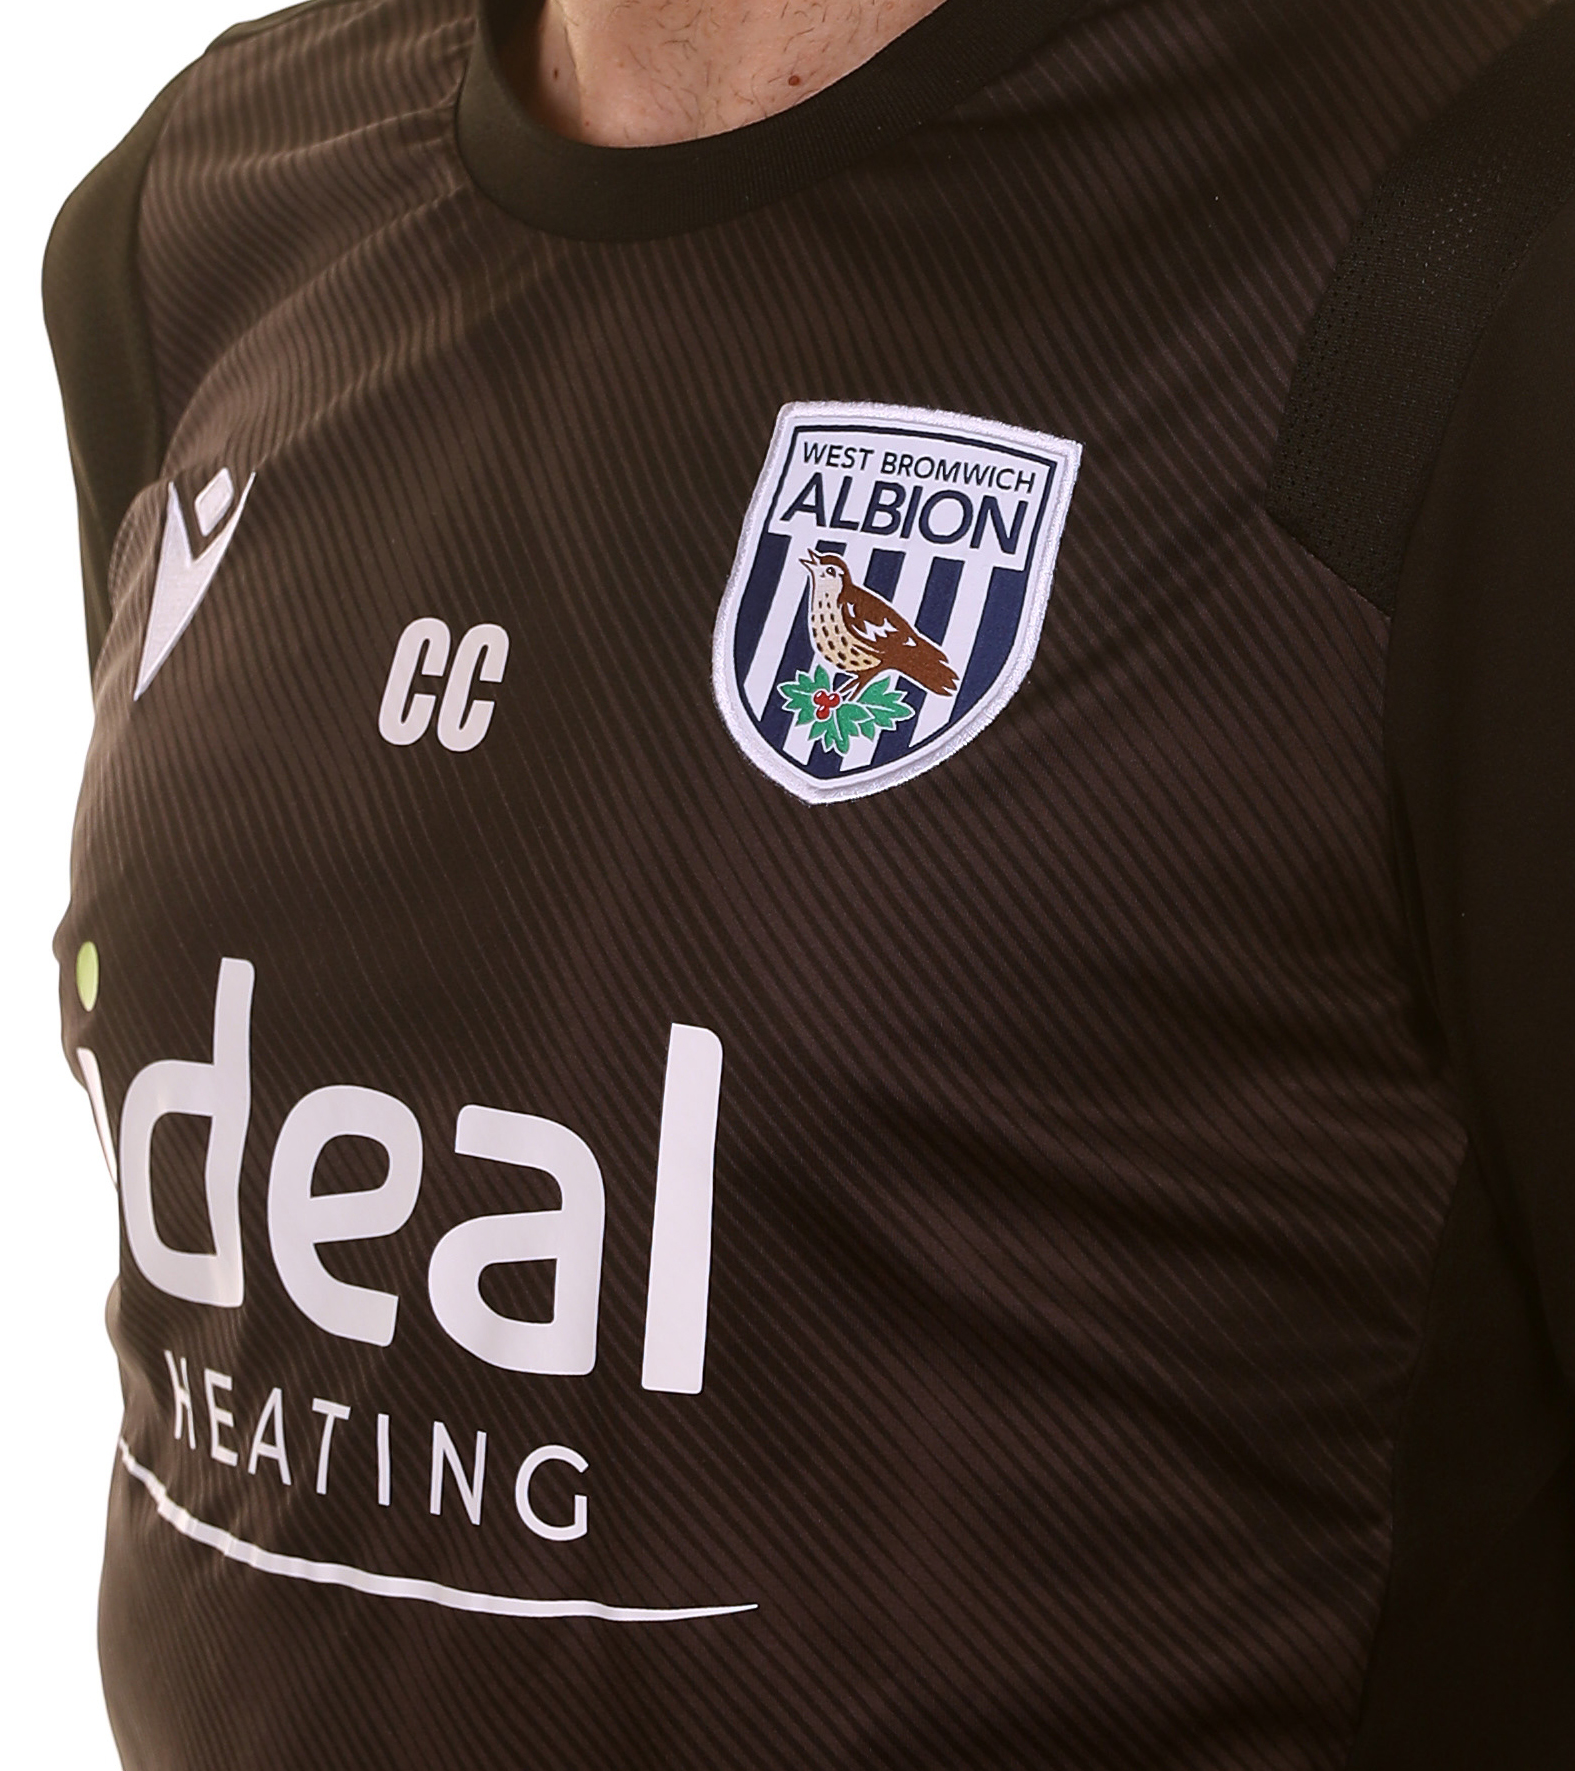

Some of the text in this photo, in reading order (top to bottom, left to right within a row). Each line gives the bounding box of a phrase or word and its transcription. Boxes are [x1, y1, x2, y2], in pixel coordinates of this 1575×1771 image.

[781, 473, 1028, 554] ALBION
[803, 441, 1036, 494] WEST BROMWICH
[377, 616, 510, 752] CC
[163, 1349, 590, 1542] HEATING
